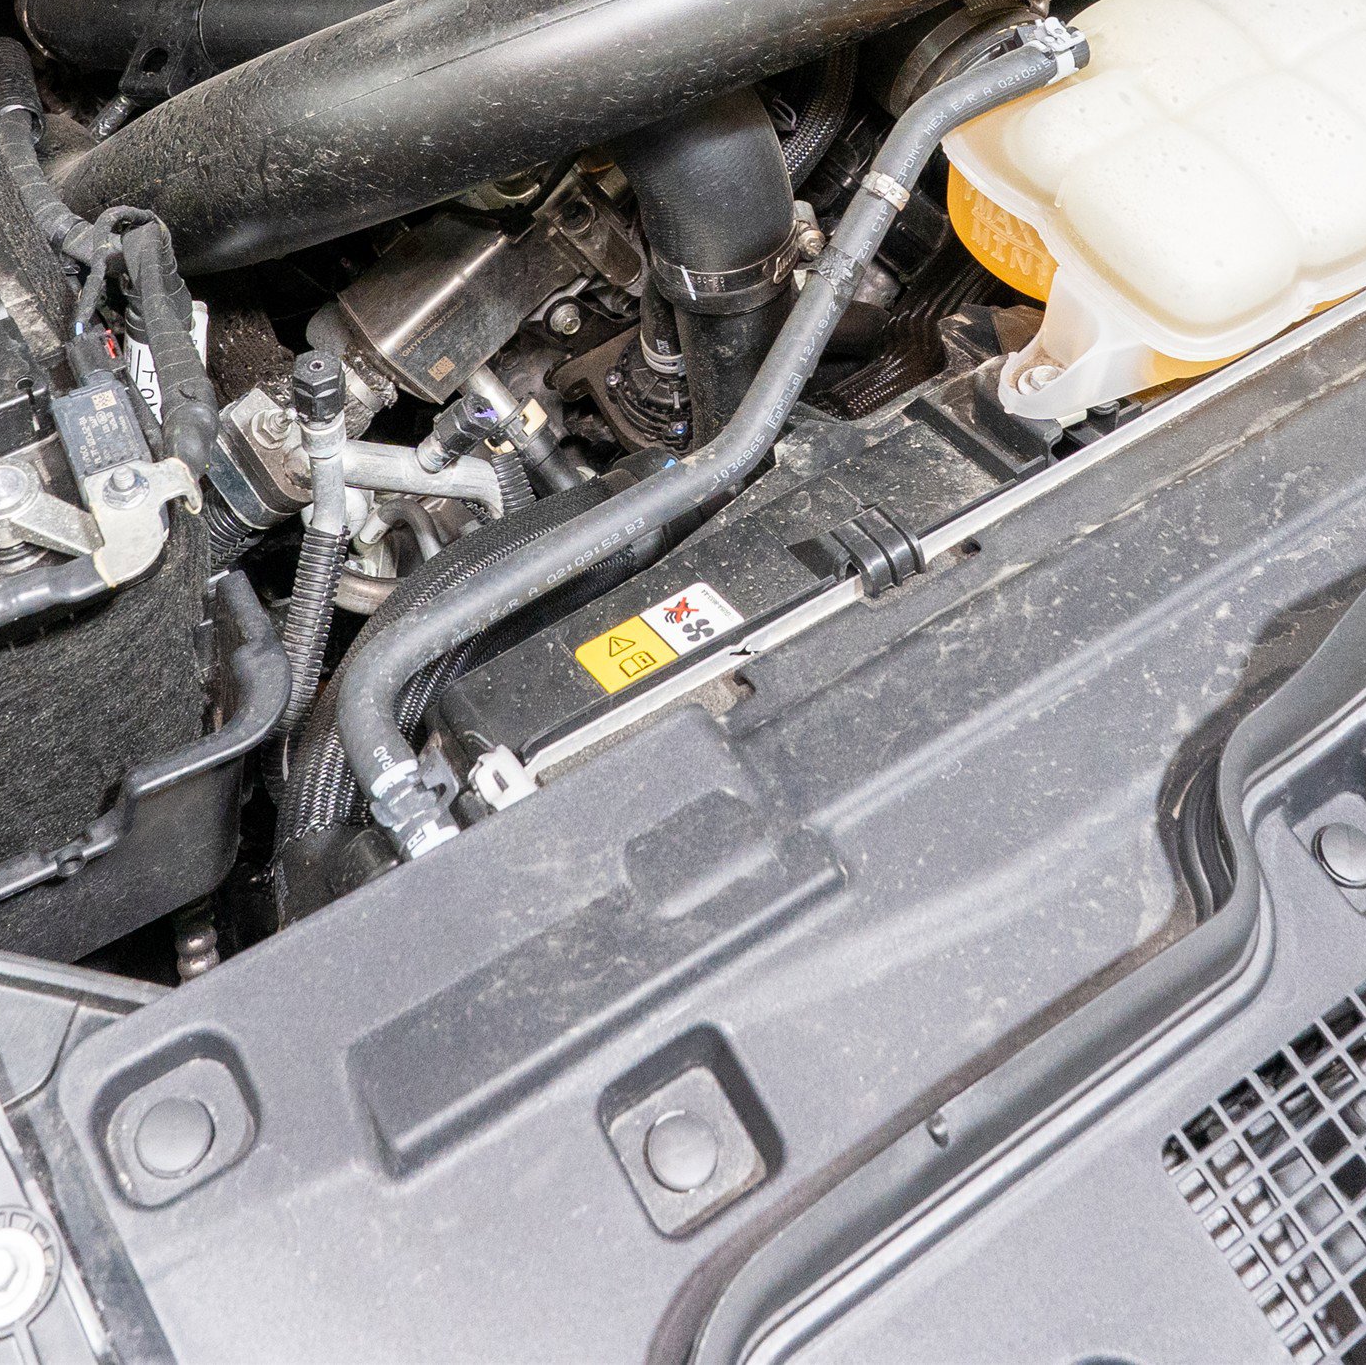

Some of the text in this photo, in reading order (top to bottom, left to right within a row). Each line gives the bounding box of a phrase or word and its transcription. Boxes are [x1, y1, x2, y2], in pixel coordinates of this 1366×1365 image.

[924, 112, 948, 136] MEX
[951, 93, 978, 112] E/R
[982, 87, 993, 97] A
[872, 204, 889, 233] CIP
[971, 218, 1034, 276] MIN
[528, 586, 539, 598] A
[623, 517, 647, 539] B3
